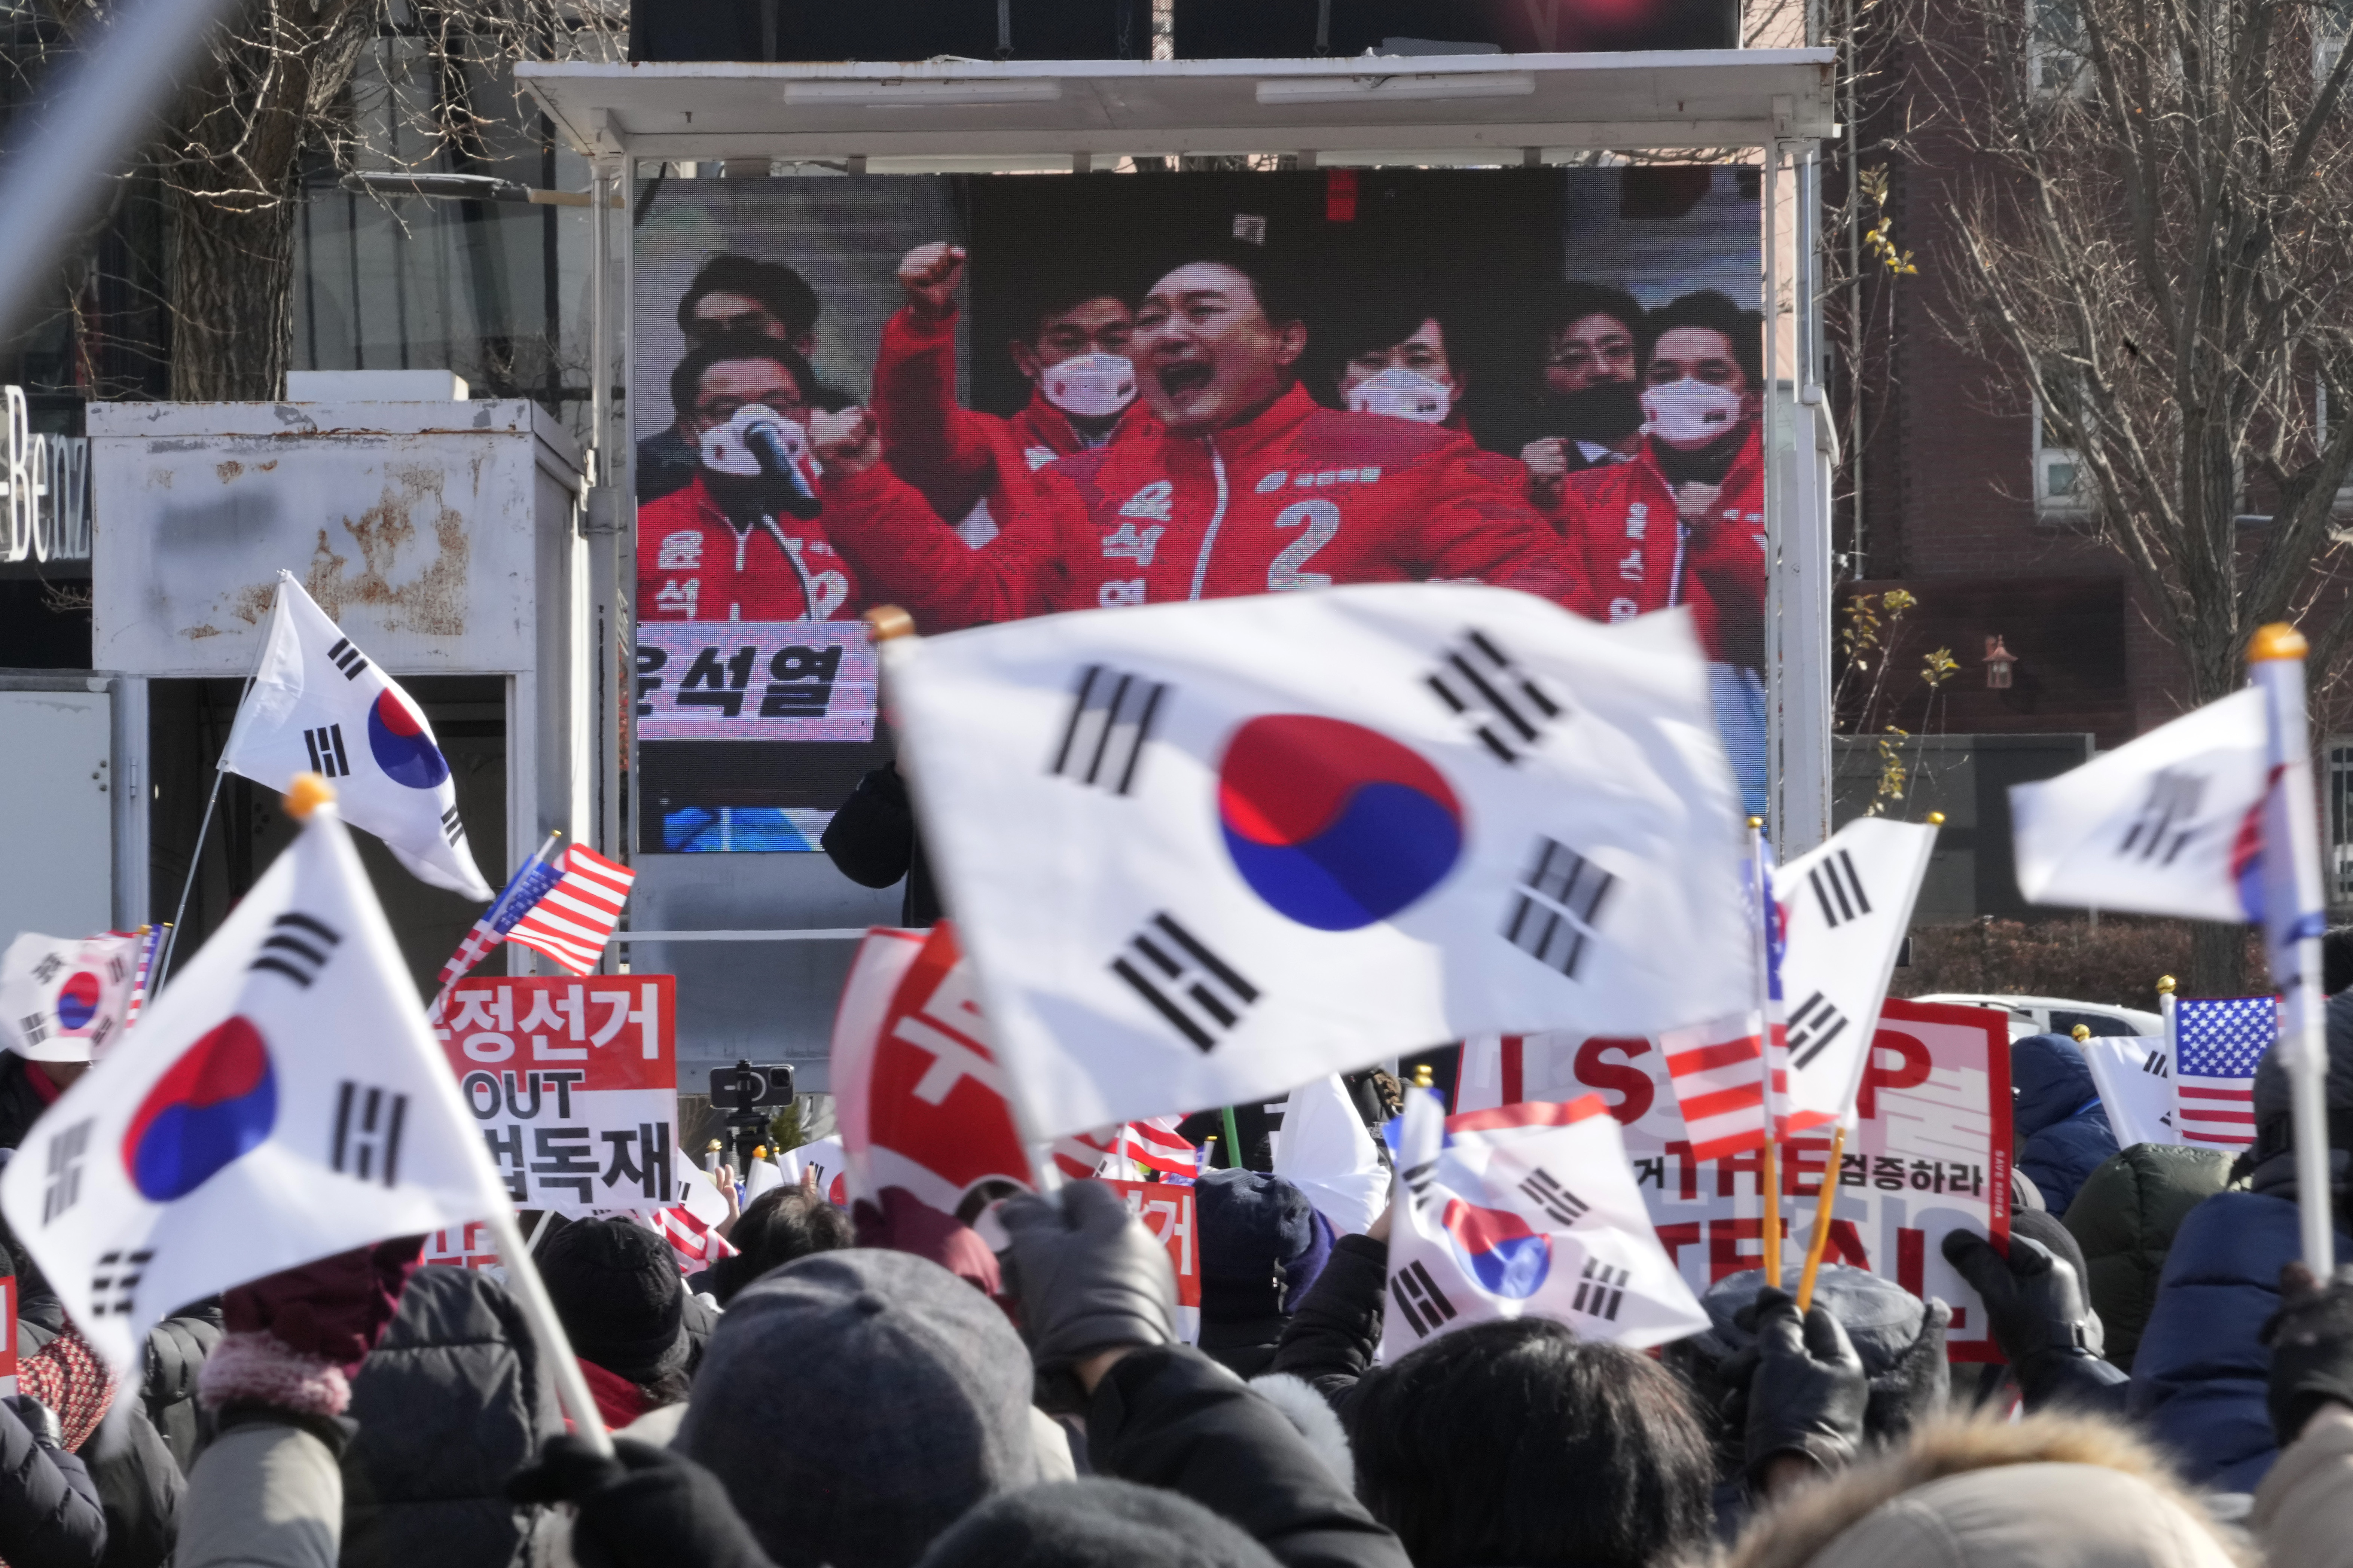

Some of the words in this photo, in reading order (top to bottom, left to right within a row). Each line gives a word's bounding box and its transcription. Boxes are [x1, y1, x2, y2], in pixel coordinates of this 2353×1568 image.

[1268, 500, 1341, 591] 2
[433, 982, 659, 1063] 정선거
[461, 1069, 586, 1120] OUT
[1573, 1029, 1932, 1126] SP
[1838, 1153, 1983, 1197] 검증하라
